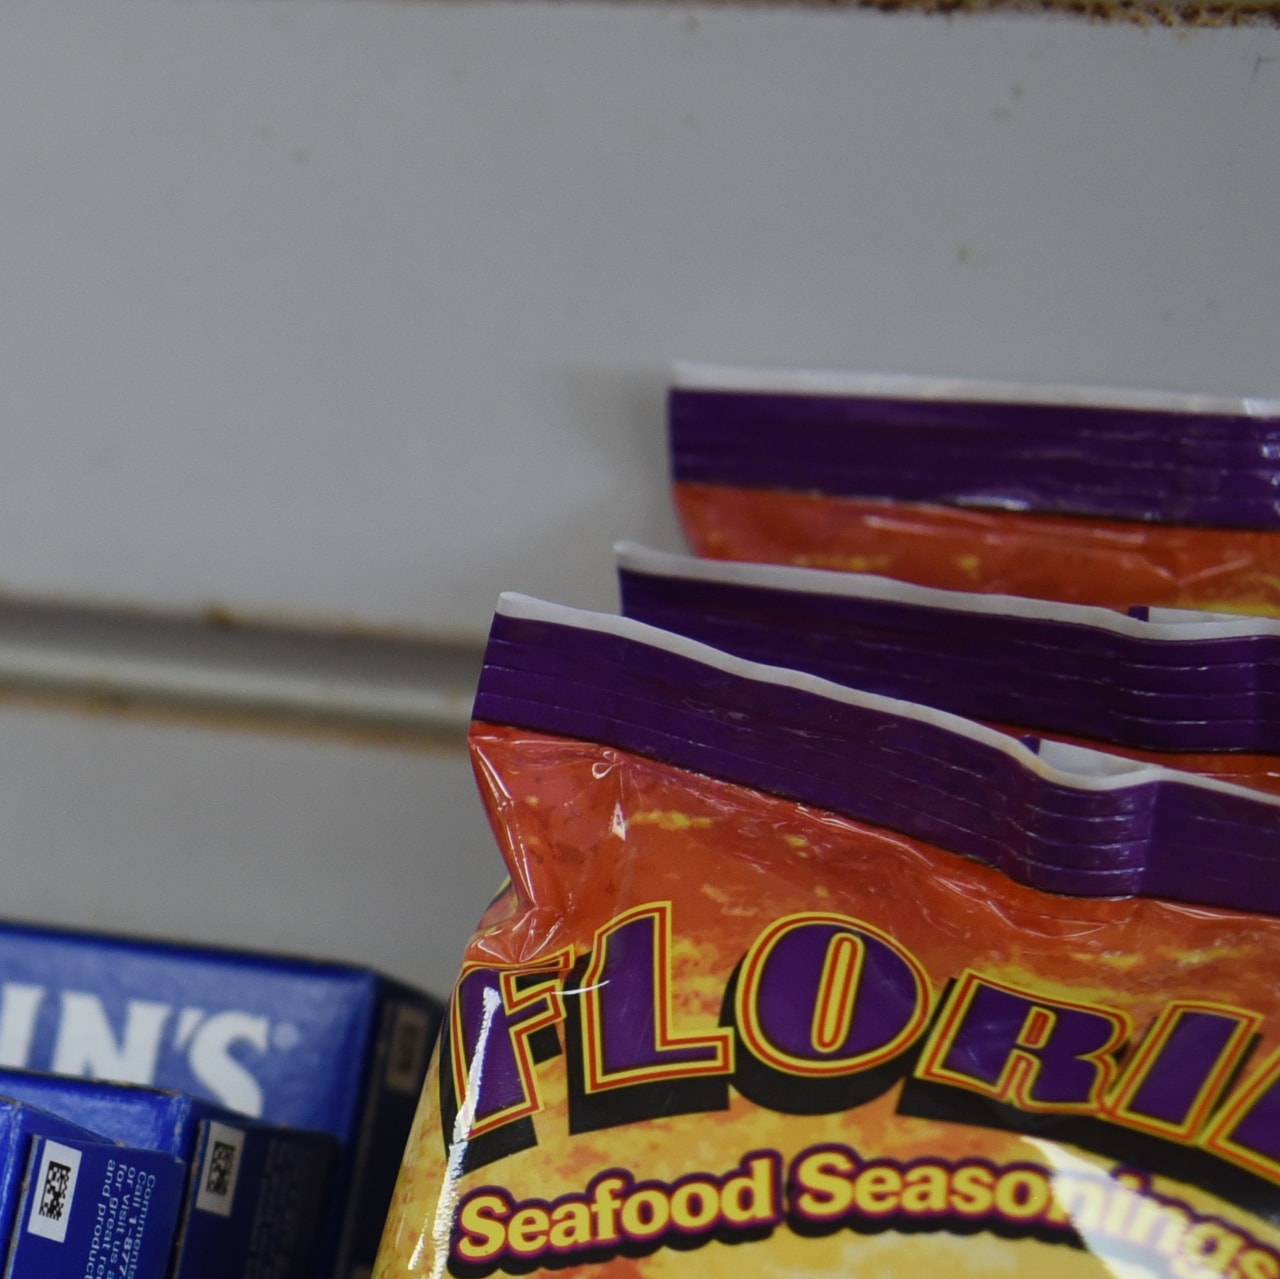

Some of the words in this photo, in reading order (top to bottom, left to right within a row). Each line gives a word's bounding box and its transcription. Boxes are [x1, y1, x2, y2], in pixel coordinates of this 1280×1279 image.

[101, 1159, 117, 1197] and
[113, 1162, 128, 1192] for
[125, 1166, 136, 1187] or
[132, 1170, 146, 1208] Call
[99, 1195, 120, 1251] great
[116, 1193, 132, 1234] visit
[457, 1155, 774, 1258] Seafood
[109, 1240, 120, 1264] us
